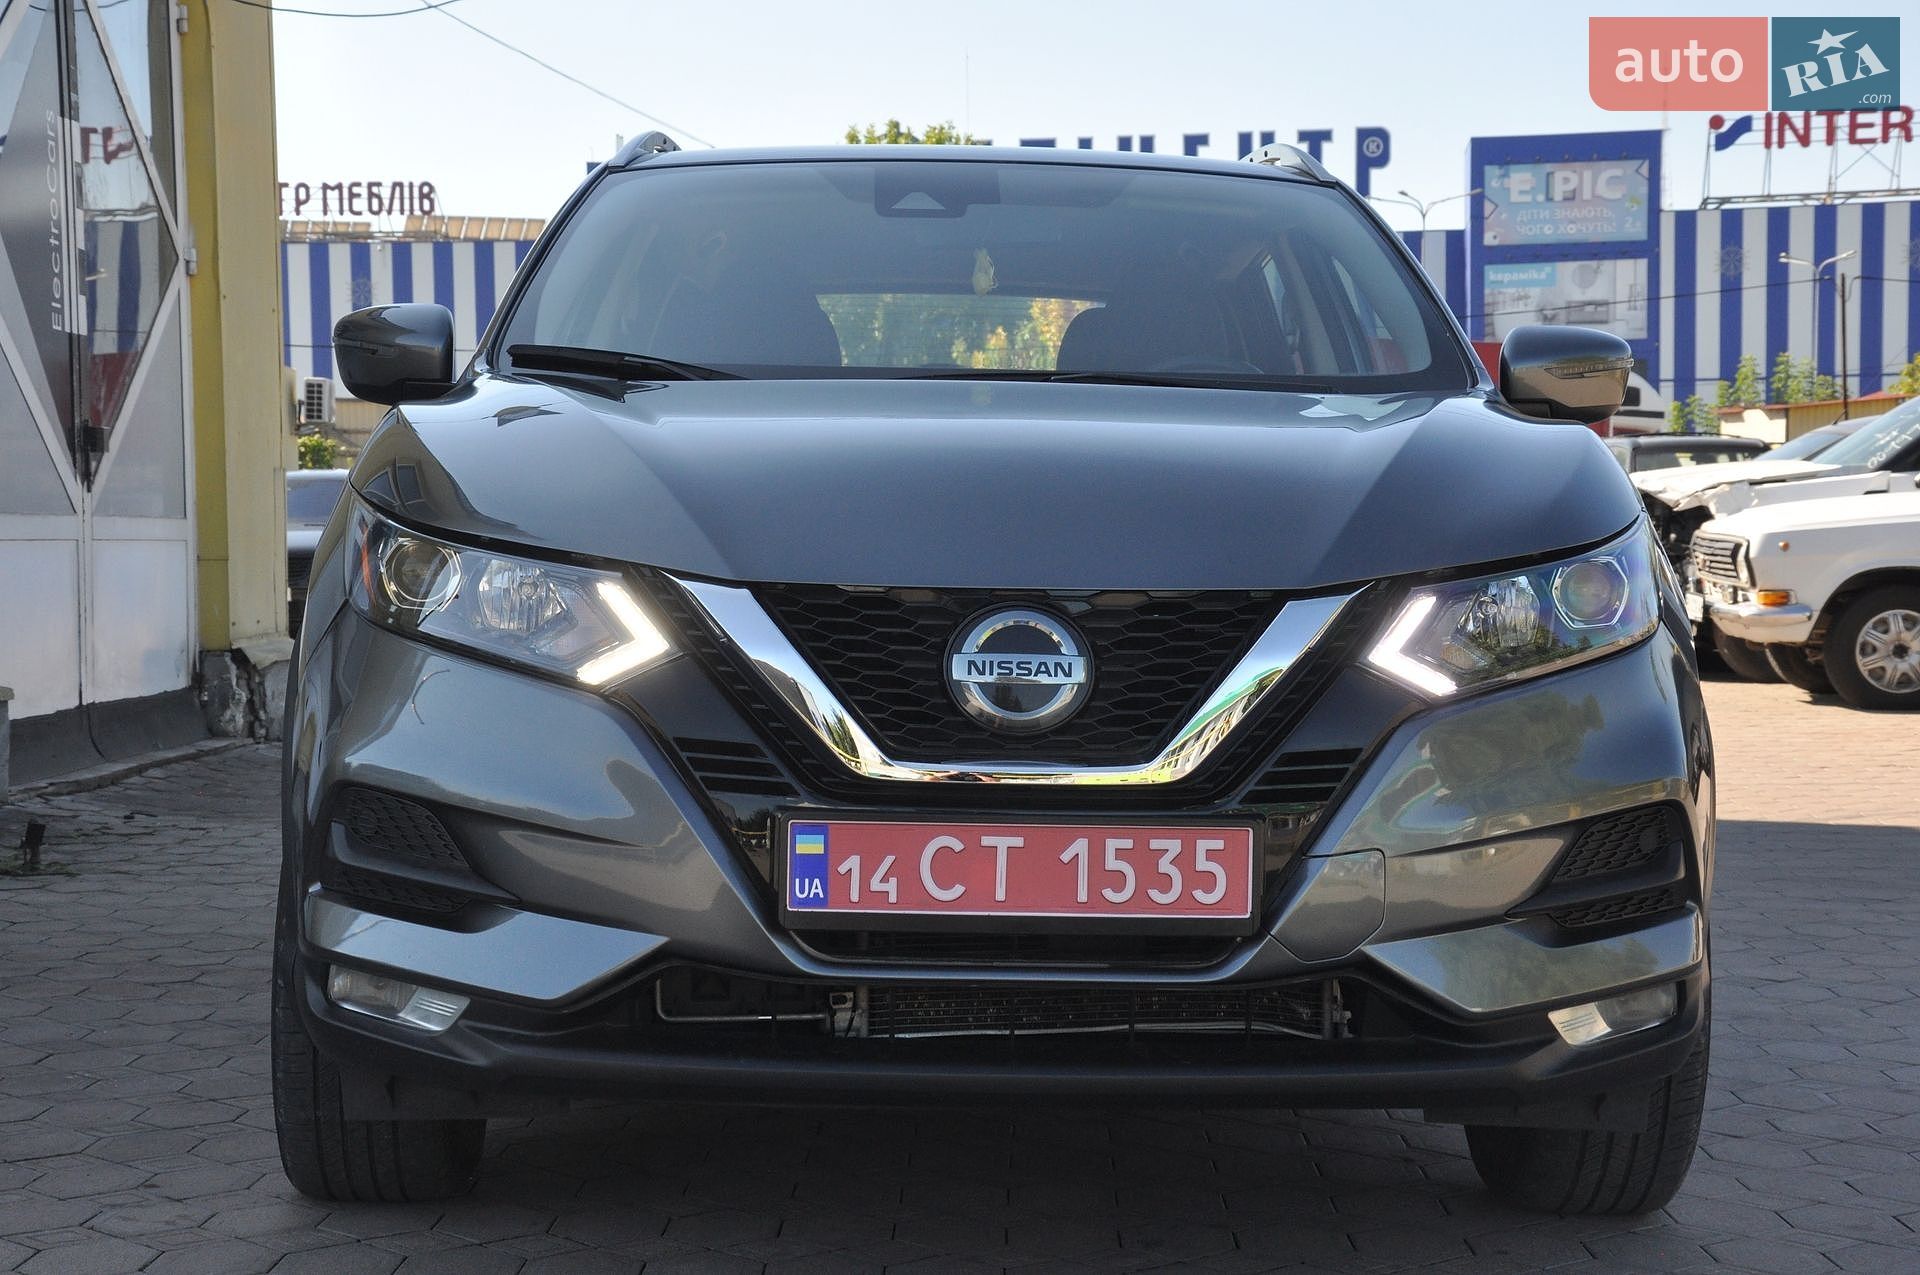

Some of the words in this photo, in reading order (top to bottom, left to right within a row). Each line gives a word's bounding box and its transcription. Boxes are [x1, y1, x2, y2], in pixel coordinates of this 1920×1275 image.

[1764, 106, 1914, 149] INTER
[321, 181, 435, 216] МЕБЛІВ
[1506, 168, 1627, 202] E.PIC
[47, 109, 63, 331] ElectroCars
[1516, 209, 1549, 222] ДІТИ
[967, 660, 1073, 678] NISSAN
[794, 878, 824, 898] UA
[837, 855, 897, 904] 14
[919, 835, 1024, 902] CT
[1059, 838, 1227, 905] 1535
